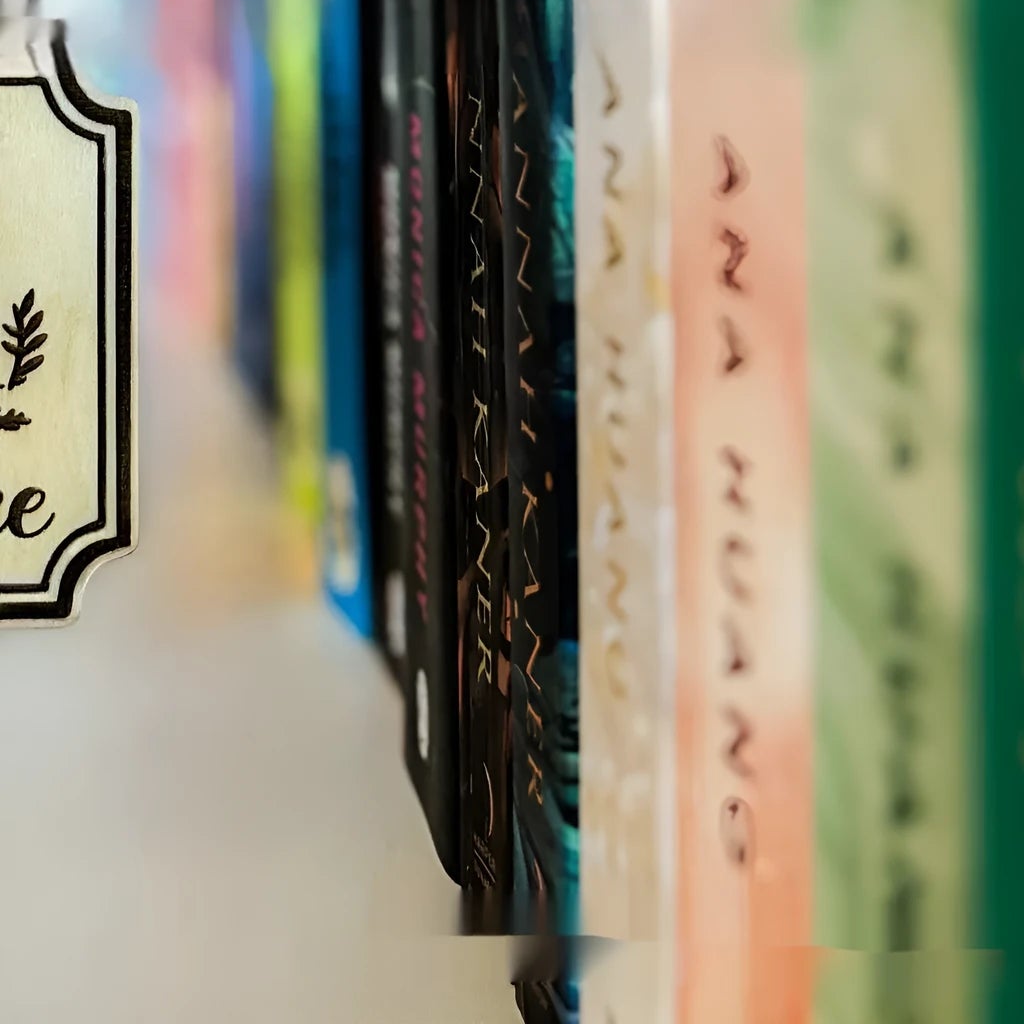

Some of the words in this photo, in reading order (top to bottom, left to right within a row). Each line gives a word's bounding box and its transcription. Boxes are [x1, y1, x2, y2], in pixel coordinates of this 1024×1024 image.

[409, 114, 427, 342] MONICA
[712, 134, 752, 377] ANA
[413, 372, 429, 625] MURPHY
[473, 389, 493, 684] KANER
[521, 481, 544, 807] KANER
